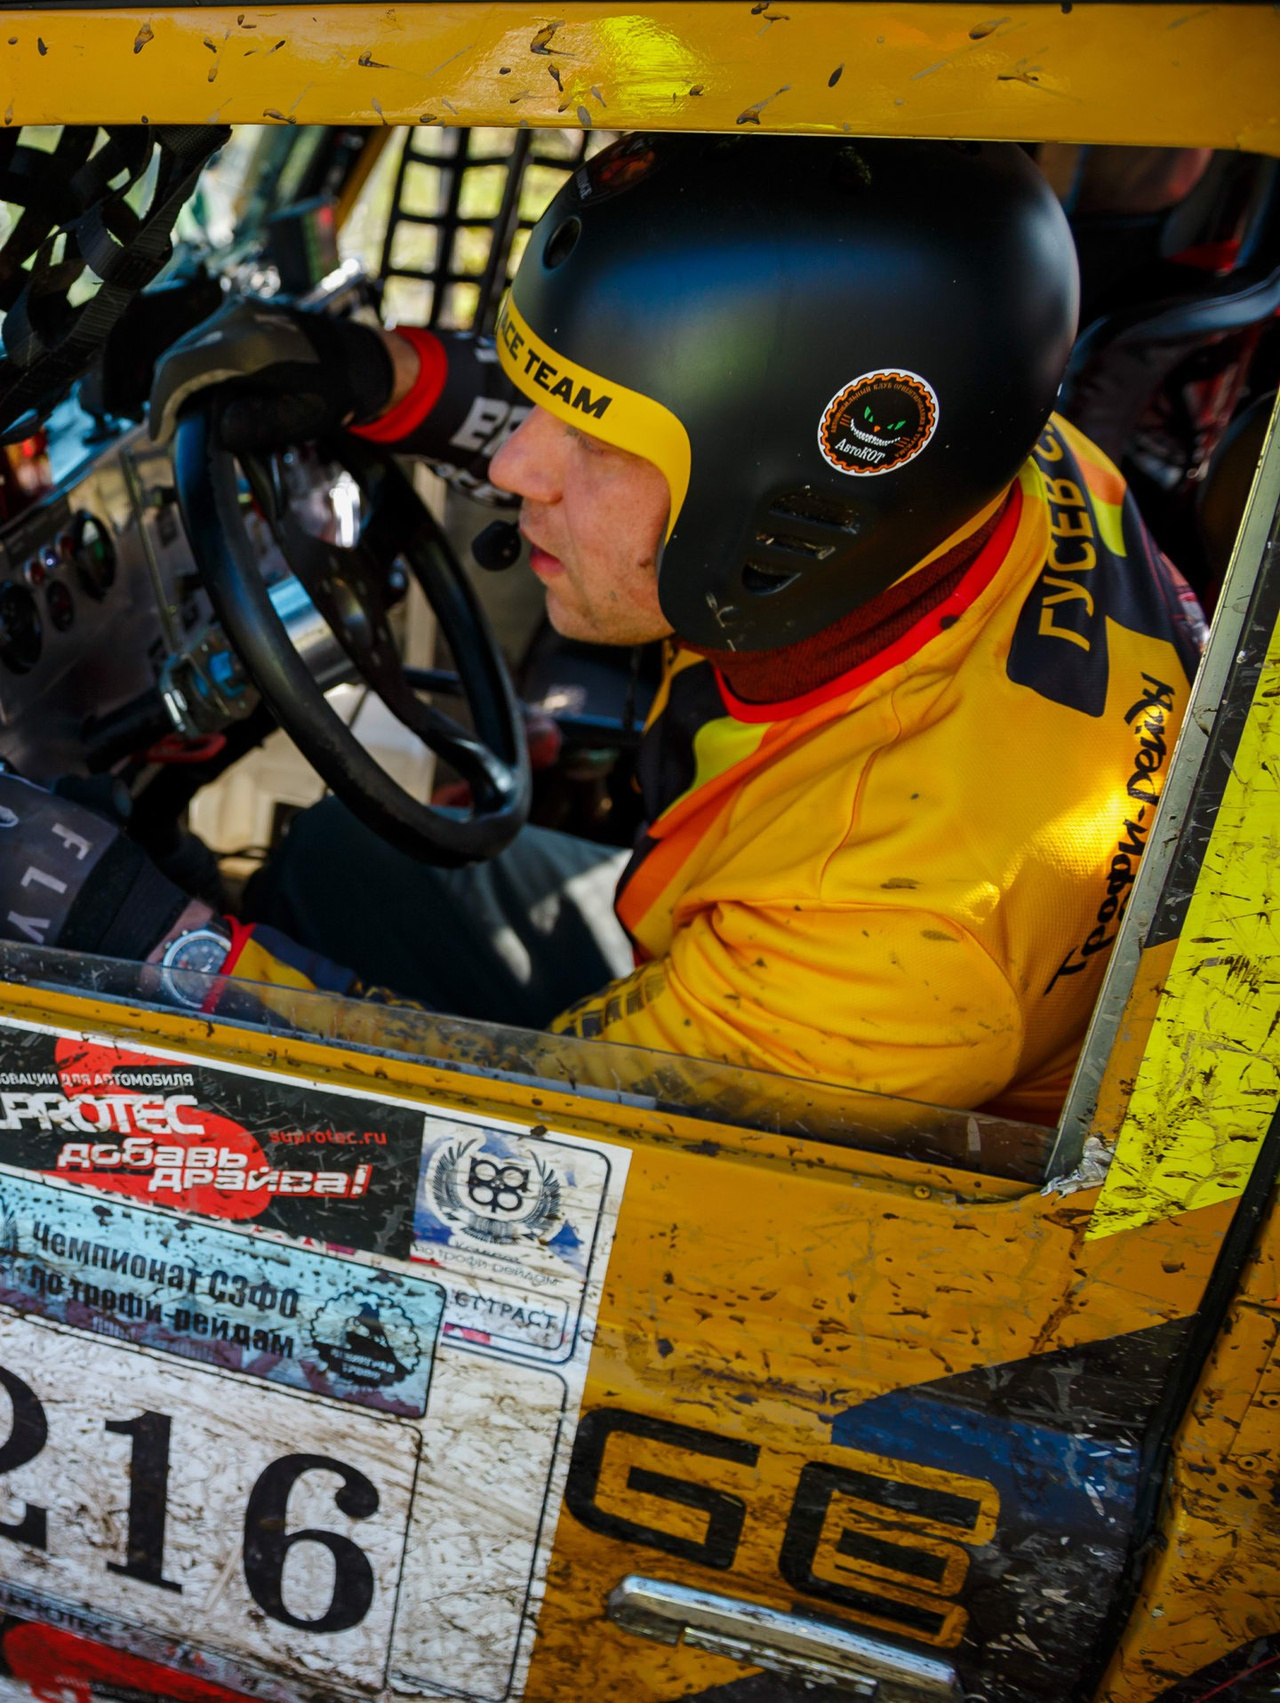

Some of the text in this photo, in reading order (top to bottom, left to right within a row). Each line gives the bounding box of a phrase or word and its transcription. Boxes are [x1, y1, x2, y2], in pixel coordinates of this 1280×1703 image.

[501, 313, 613, 419] ACE TEAM
[835, 438, 886, 463] АвтоКОТ
[1038, 471, 1096, 652] ГУСЕВ
[8, 823, 91, 944] FLY
[60, 1072, 92, 1088] ДЛЯ
[94, 1073, 194, 1088] АВТОМОБИЛЯ
[59, 1138, 248, 1168] добавь
[270, 1129, 387, 1146] suprotec.ru
[148, 1163, 373, 1197] драйва!
[33, 1221, 300, 1319] Чемпионат СЗФО
